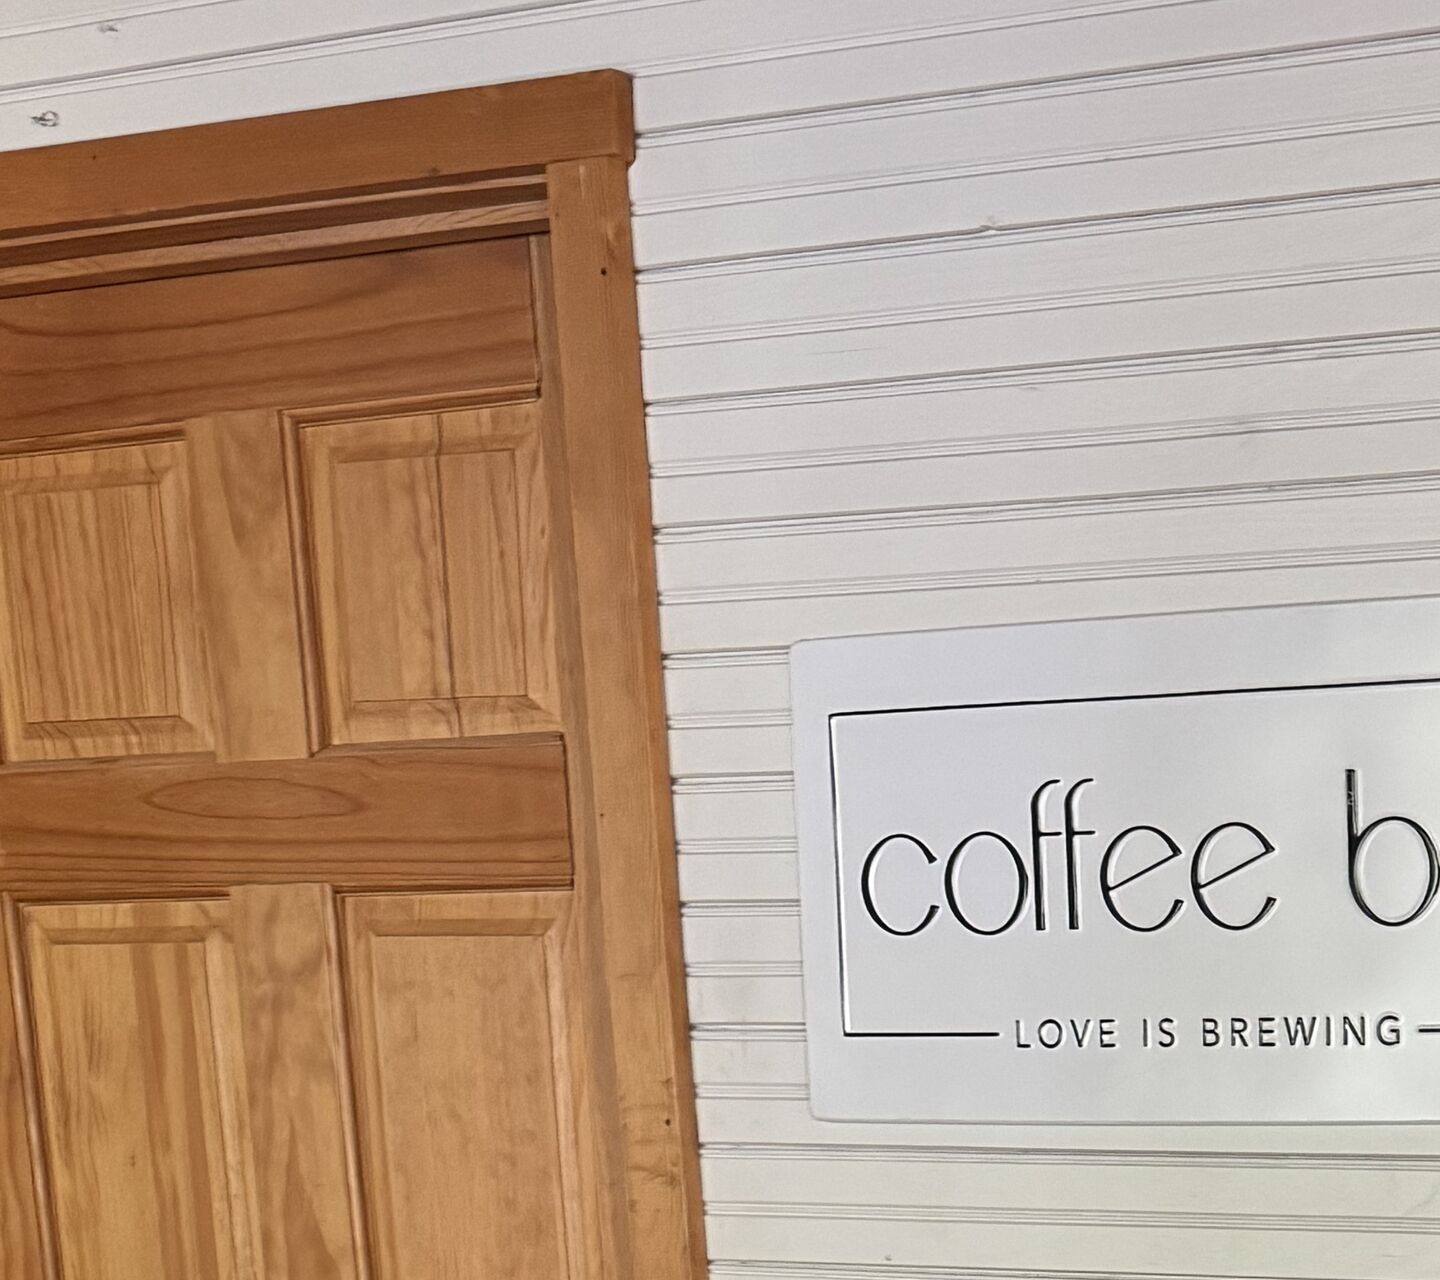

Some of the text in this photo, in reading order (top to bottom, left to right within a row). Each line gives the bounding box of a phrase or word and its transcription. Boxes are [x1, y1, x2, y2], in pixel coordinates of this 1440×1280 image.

[860, 777, 1276, 937] coffee
[1014, 1013, 1402, 1049] LOVE IS BREWING
